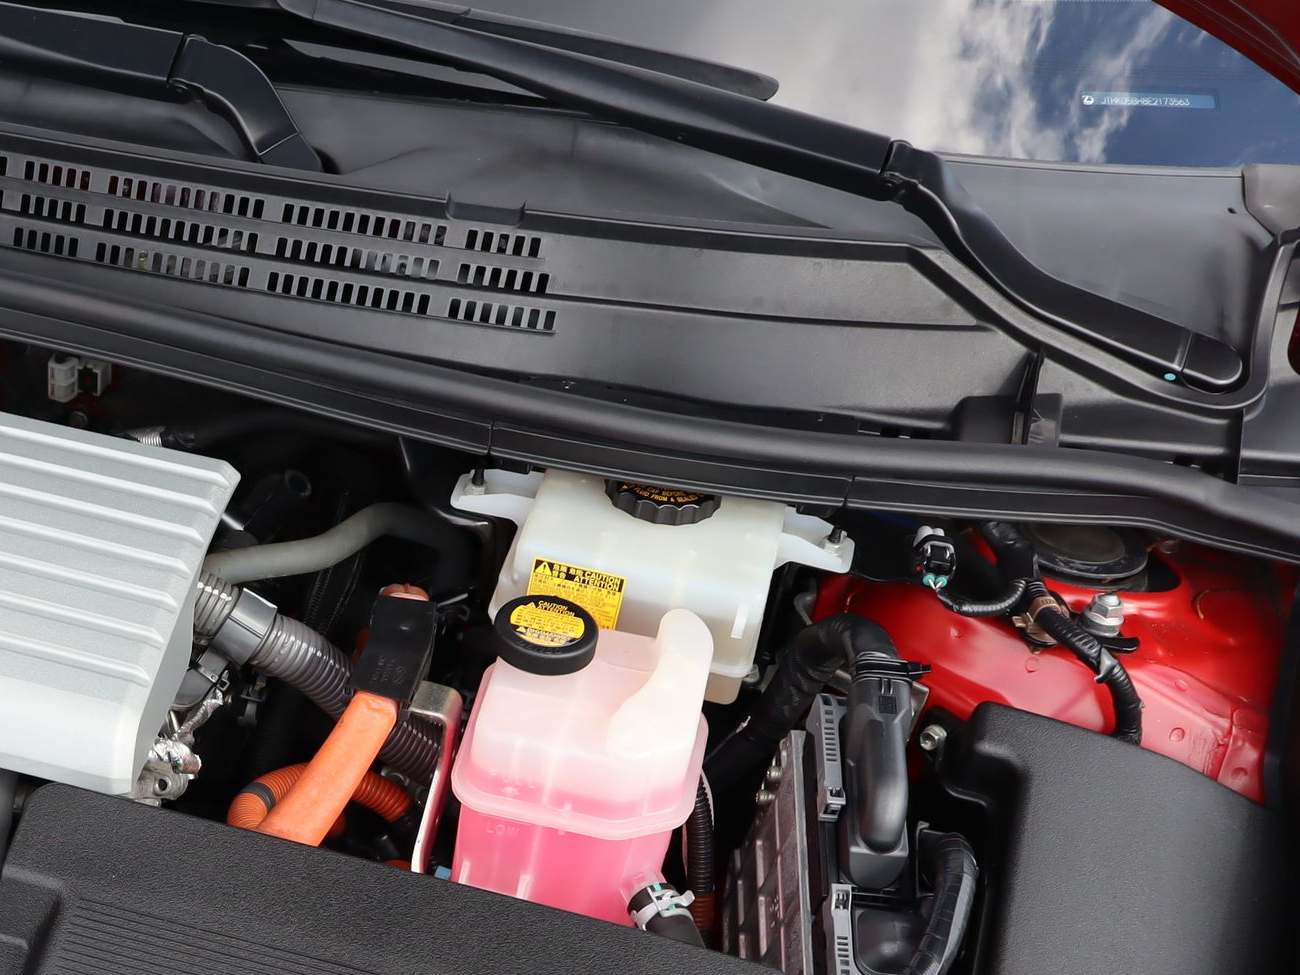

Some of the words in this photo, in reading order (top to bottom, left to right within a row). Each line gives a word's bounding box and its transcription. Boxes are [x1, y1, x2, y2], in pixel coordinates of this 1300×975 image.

[573, 576, 620, 592] ATTENTION
[584, 570, 621, 586] CAUTION
[538, 600, 568, 611] CAUTION
